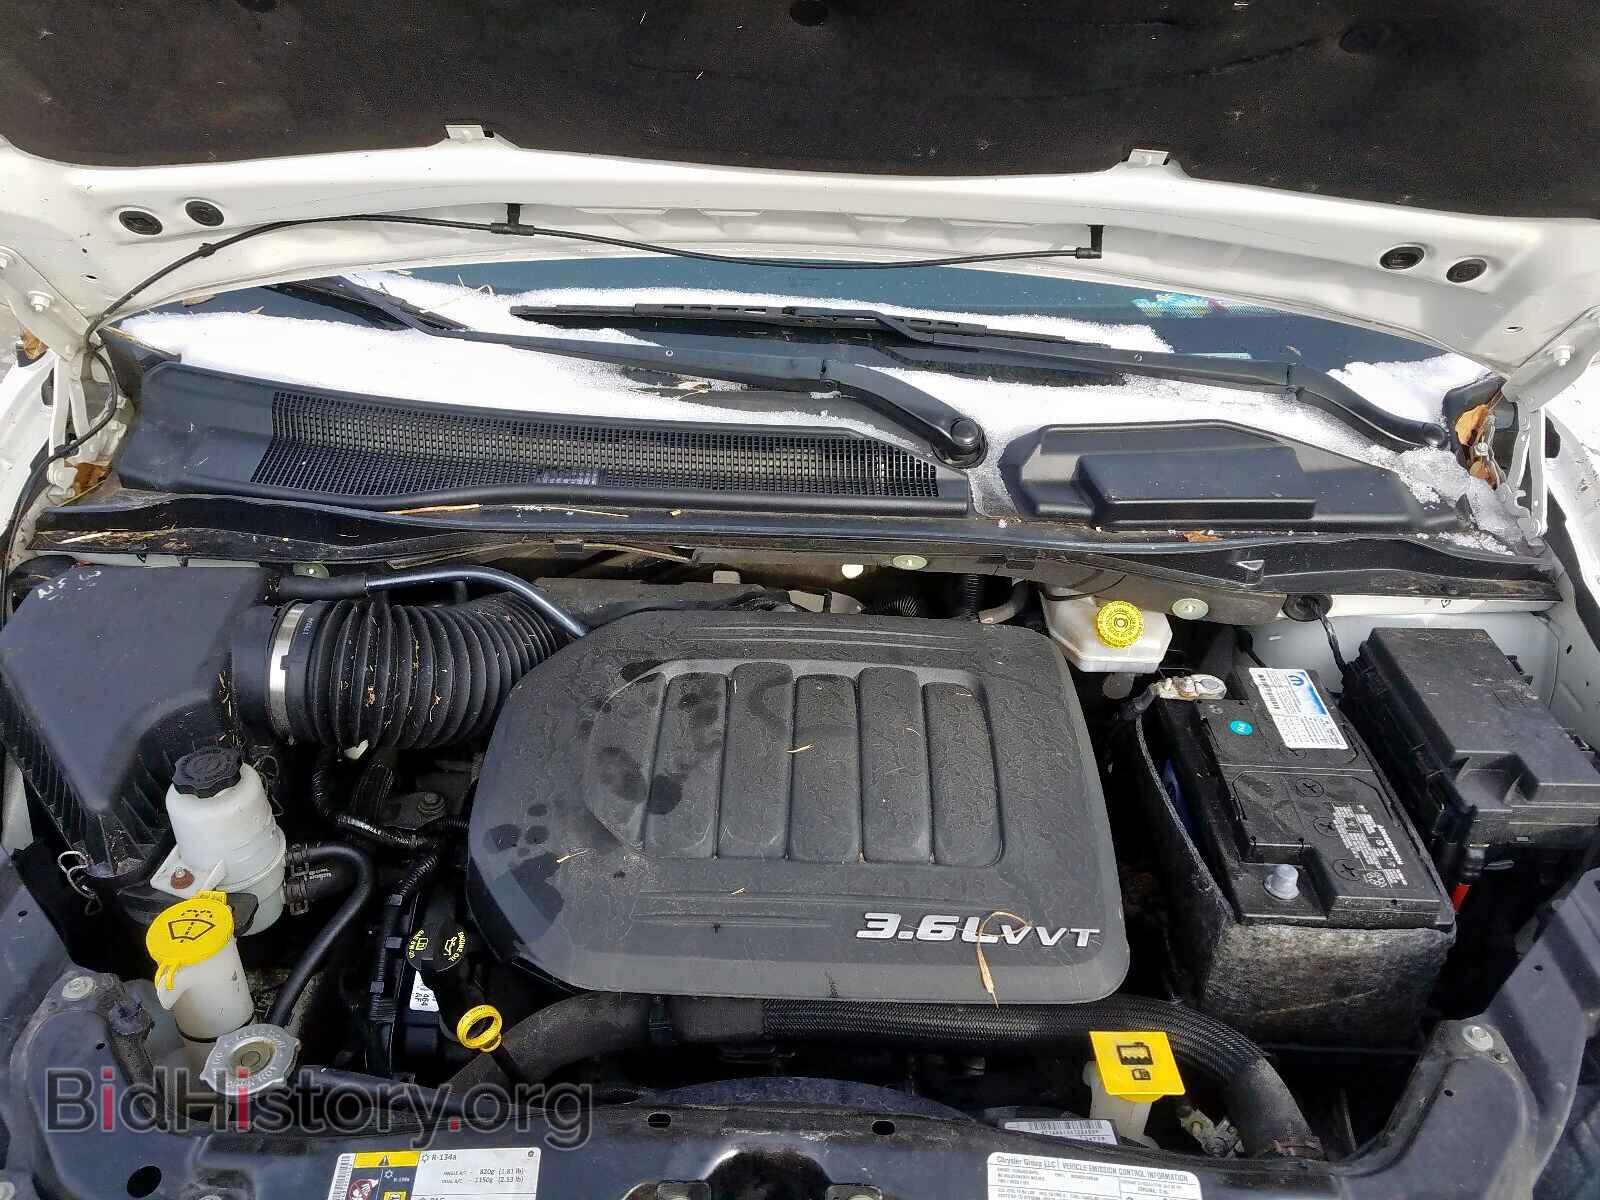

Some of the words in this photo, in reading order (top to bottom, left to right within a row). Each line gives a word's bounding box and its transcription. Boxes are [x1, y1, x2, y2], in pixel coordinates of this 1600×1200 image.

[856, 912, 999, 944] 3.6L
[999, 924, 1101, 947] VVT
[431, 1153, 457, 1161] R-134a
[996, 1155, 1022, 1165] Chrysler
[1062, 1162, 1089, 1172] VEHICLE
[1119, 1168, 1146, 1177] CONTROL
[1147, 1171, 1188, 1182] INFORMATION
